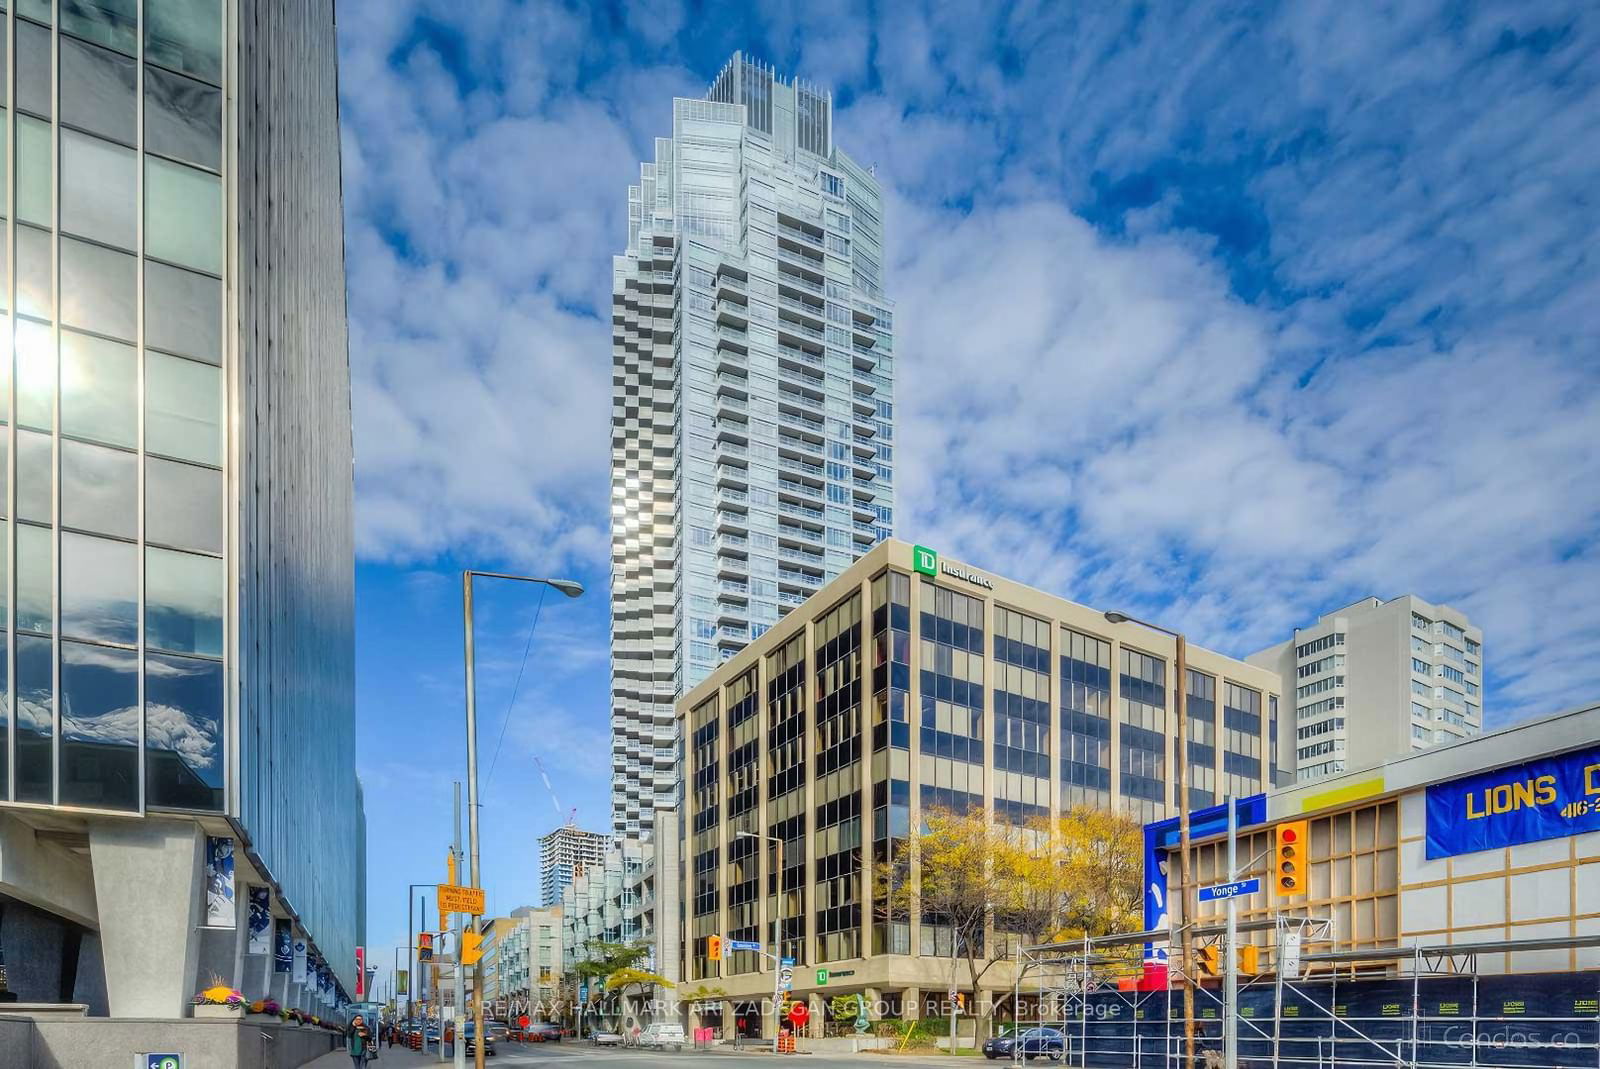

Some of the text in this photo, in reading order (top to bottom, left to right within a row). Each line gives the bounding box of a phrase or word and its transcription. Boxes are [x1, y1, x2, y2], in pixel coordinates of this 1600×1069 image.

[918, 550, 993, 590] TD Insurance
[1466, 775, 1557, 820] LIONS
[1211, 885, 1238, 897] Yonge
